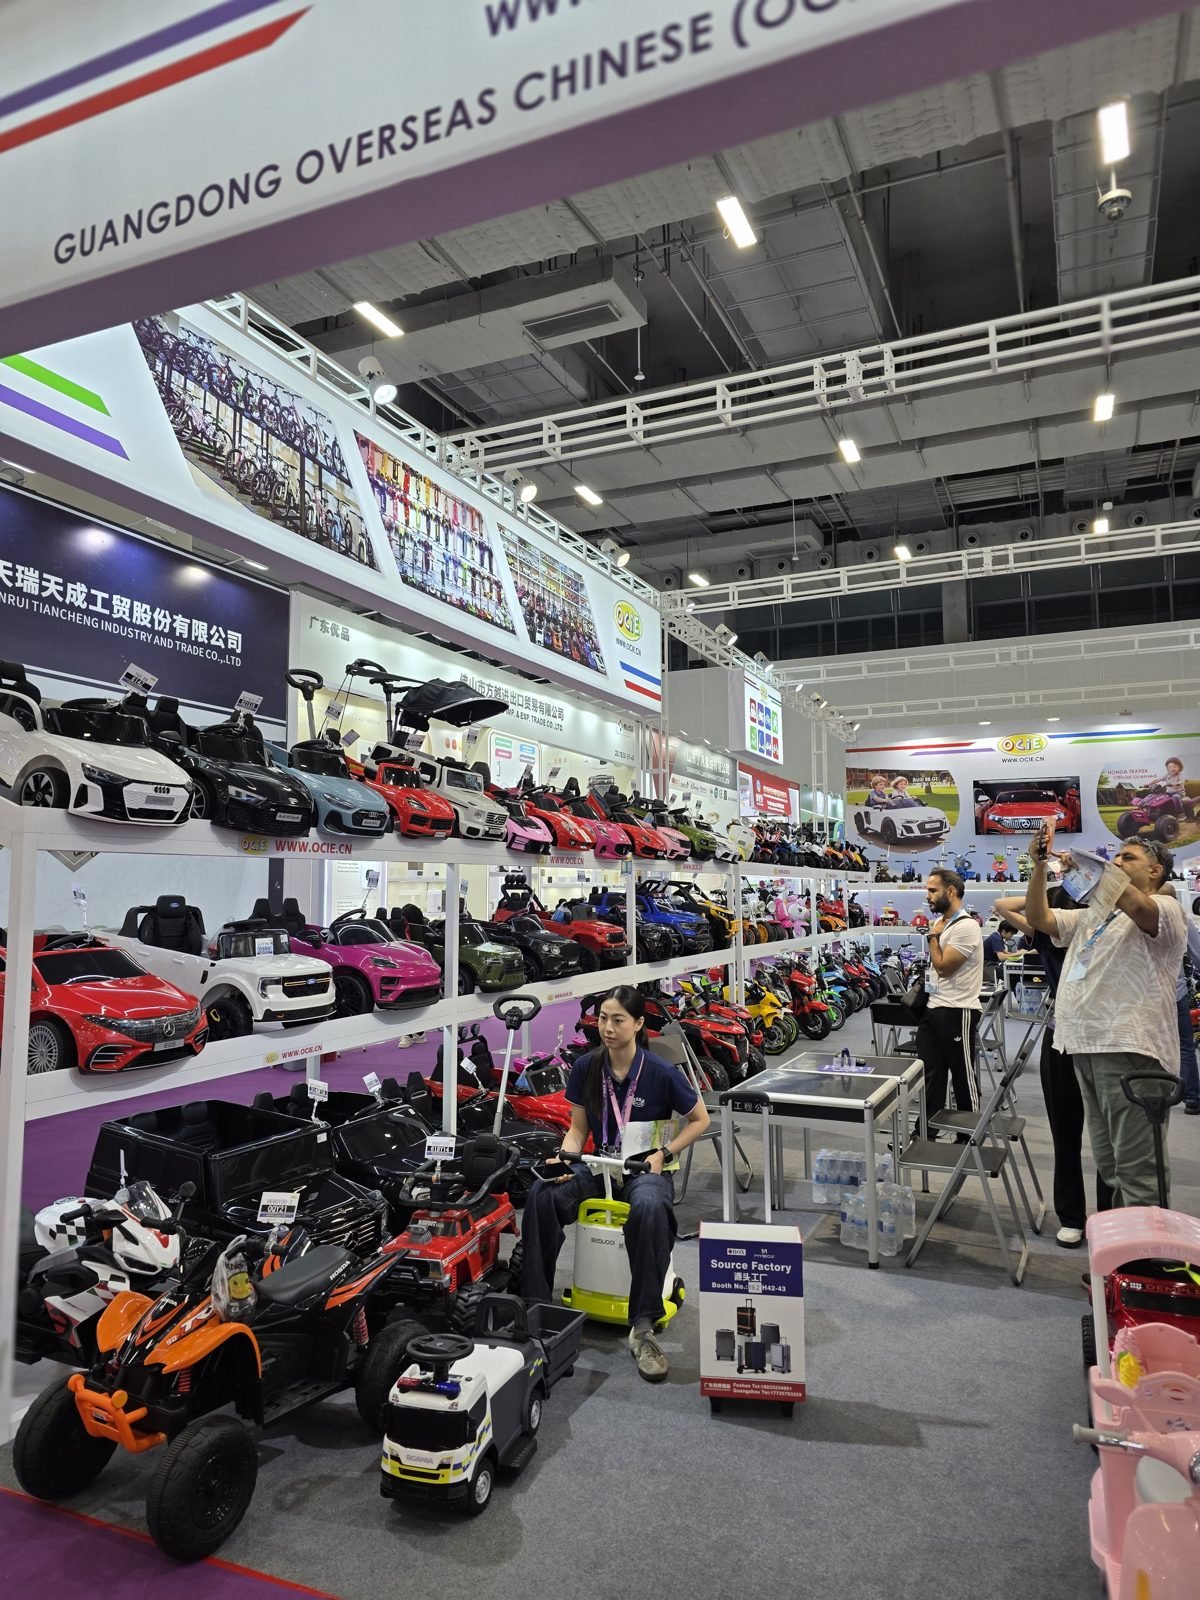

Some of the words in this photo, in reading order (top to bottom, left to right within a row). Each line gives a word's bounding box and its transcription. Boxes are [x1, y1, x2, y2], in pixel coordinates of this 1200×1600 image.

[54, 164, 282, 265] GUANGDONG
[296, 88, 498, 185] OVERSEAS
[514, 12, 714, 111] CHINESE
[32, 600, 99, 629] TIANCHENG
[101, 619, 152, 643] INDUSTRY
[153, 635, 174, 649] AND
[175, 640, 204, 657] TRADE
[309, 615, 350, 642] 广东优品
[531, 715, 546, 727] TRADE
[1001, 737, 1043, 751] OCIE
[1001, 756, 1045, 764] WWW.OCIE.CN
[275, 839, 353, 855] WWW.OCIE.CN
[281, 1044, 323, 1059] WWW.OCIE.CN
[329, 1260, 351, 1281] HONDA
[710, 1259, 748, 1270] Source
[751, 1261, 792, 1275] Factory
[711, 1281, 732, 1289] Booth
[406, 1454, 434, 1464] SCANIA
